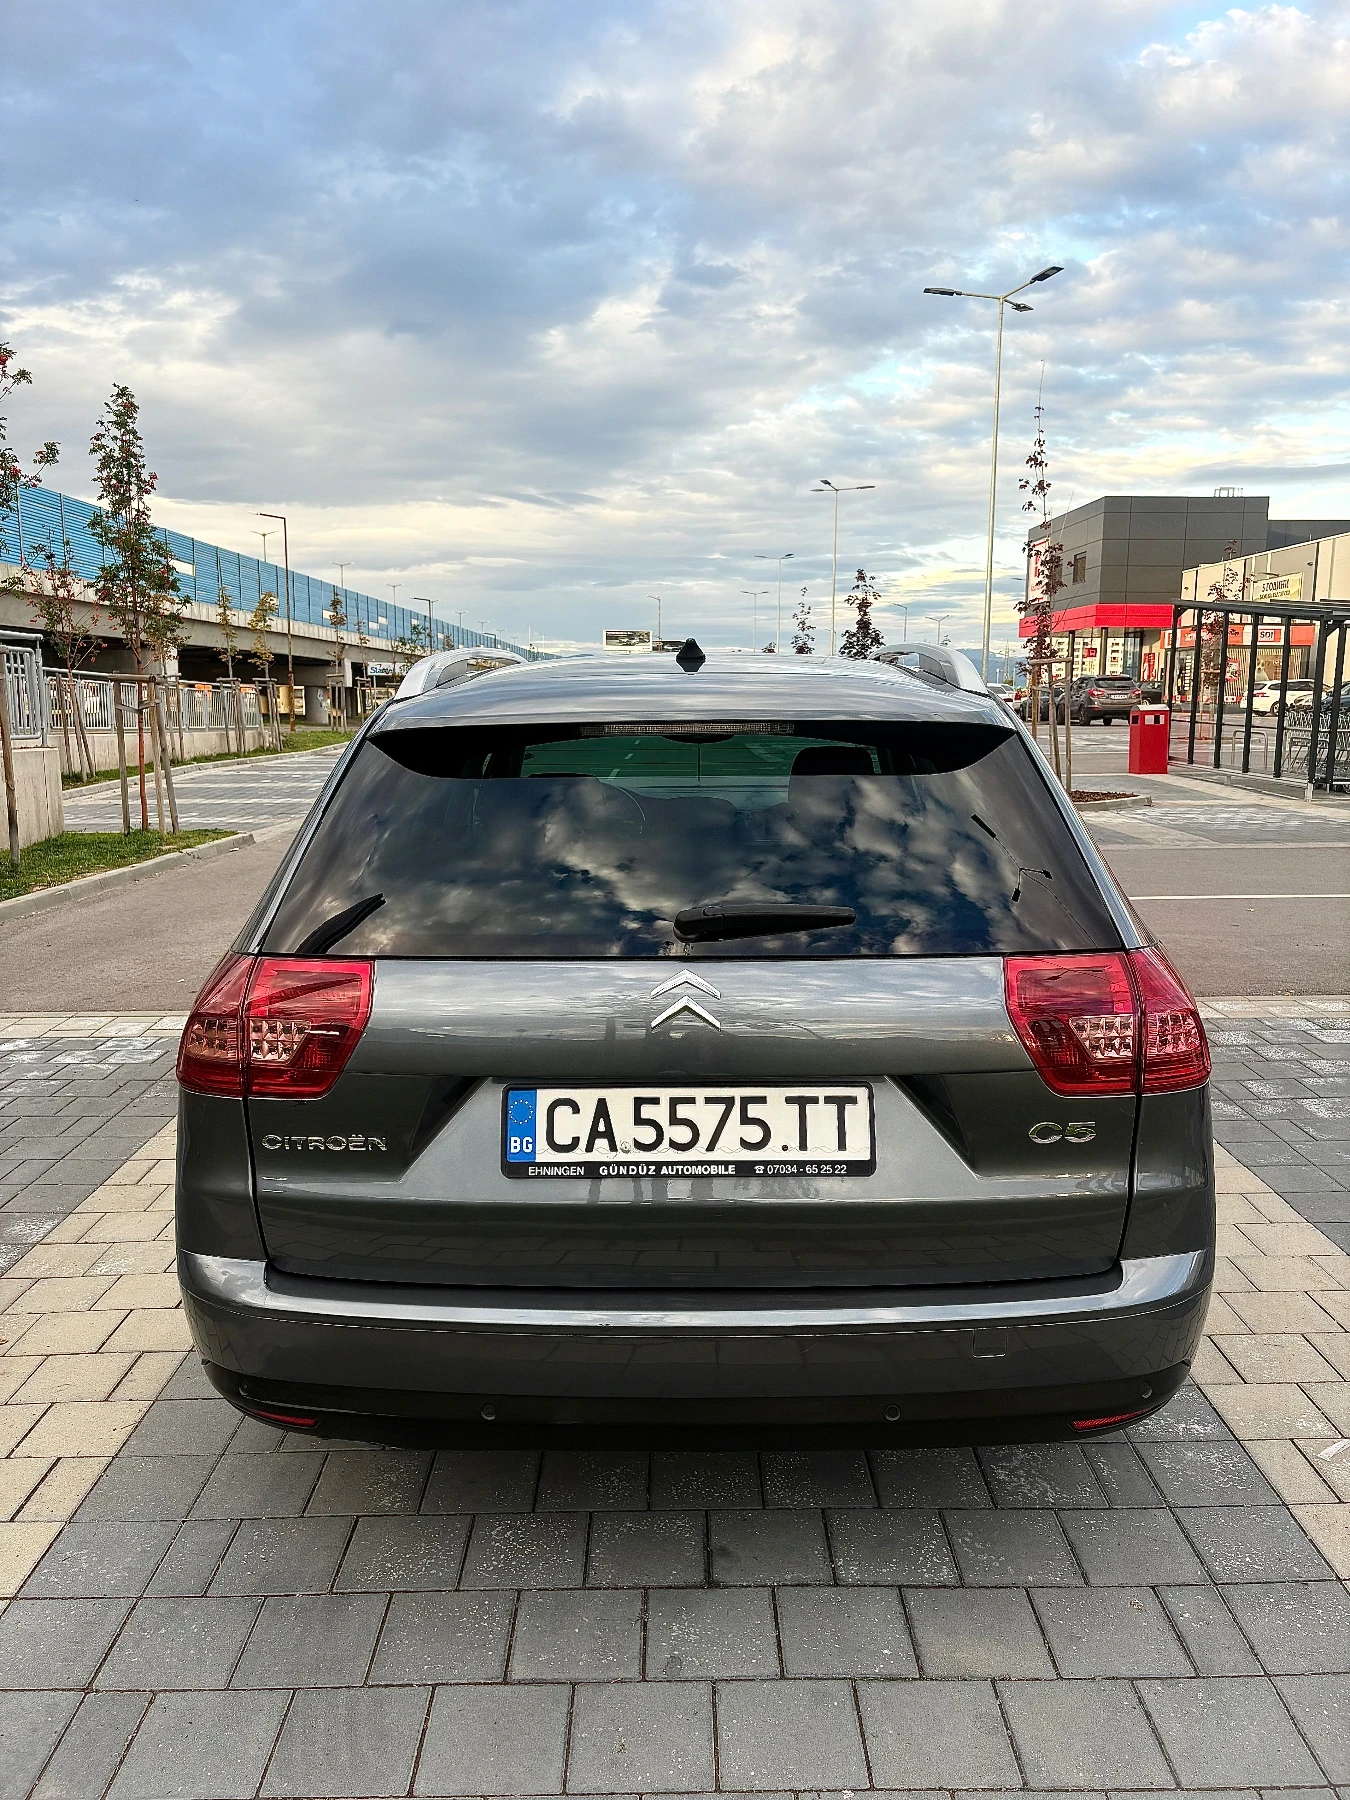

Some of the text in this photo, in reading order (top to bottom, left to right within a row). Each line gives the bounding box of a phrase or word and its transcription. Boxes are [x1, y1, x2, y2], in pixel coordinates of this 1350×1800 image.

[545, 1095, 858, 1153] CA 5575 TT
[1028, 1121, 1097, 1144] C5
[262, 1133, 388, 1151] CITROËN
[510, 1136, 533, 1153] BG
[528, 1166, 585, 1176] EHNINGEN
[599, 1163, 656, 1176] GÜNDÜZ
[660, 1164, 736, 1176] AUTOMOBILE
[767, 1164, 798, 1174] 07034
[805, 1164, 819, 1174] 65
[820, 1164, 834, 1174] 25
[834, 1164, 847, 1174] 22
